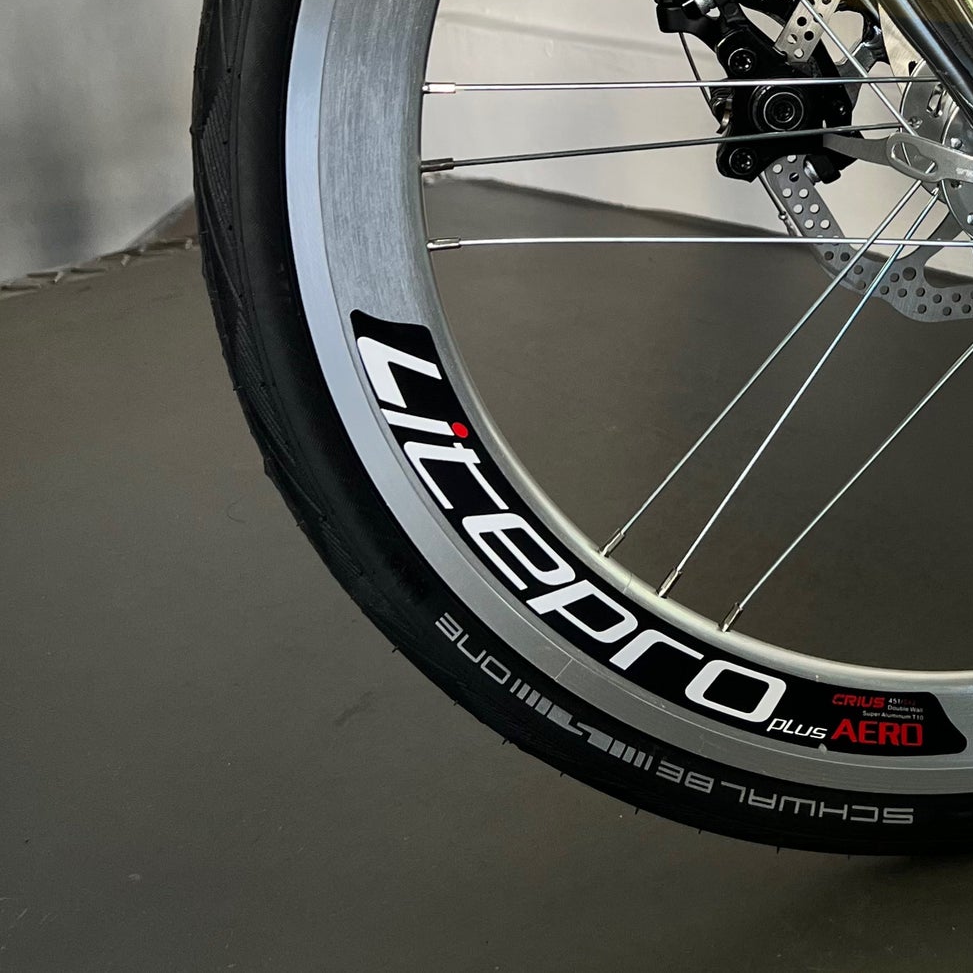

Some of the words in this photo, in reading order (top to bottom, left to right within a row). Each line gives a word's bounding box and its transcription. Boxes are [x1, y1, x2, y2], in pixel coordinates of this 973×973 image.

[435, 612, 511, 686] ONE
[832, 693, 885, 709] CRIUS
[831, 718, 923, 747] AERO
[655, 759, 914, 825] SCHWALBE
